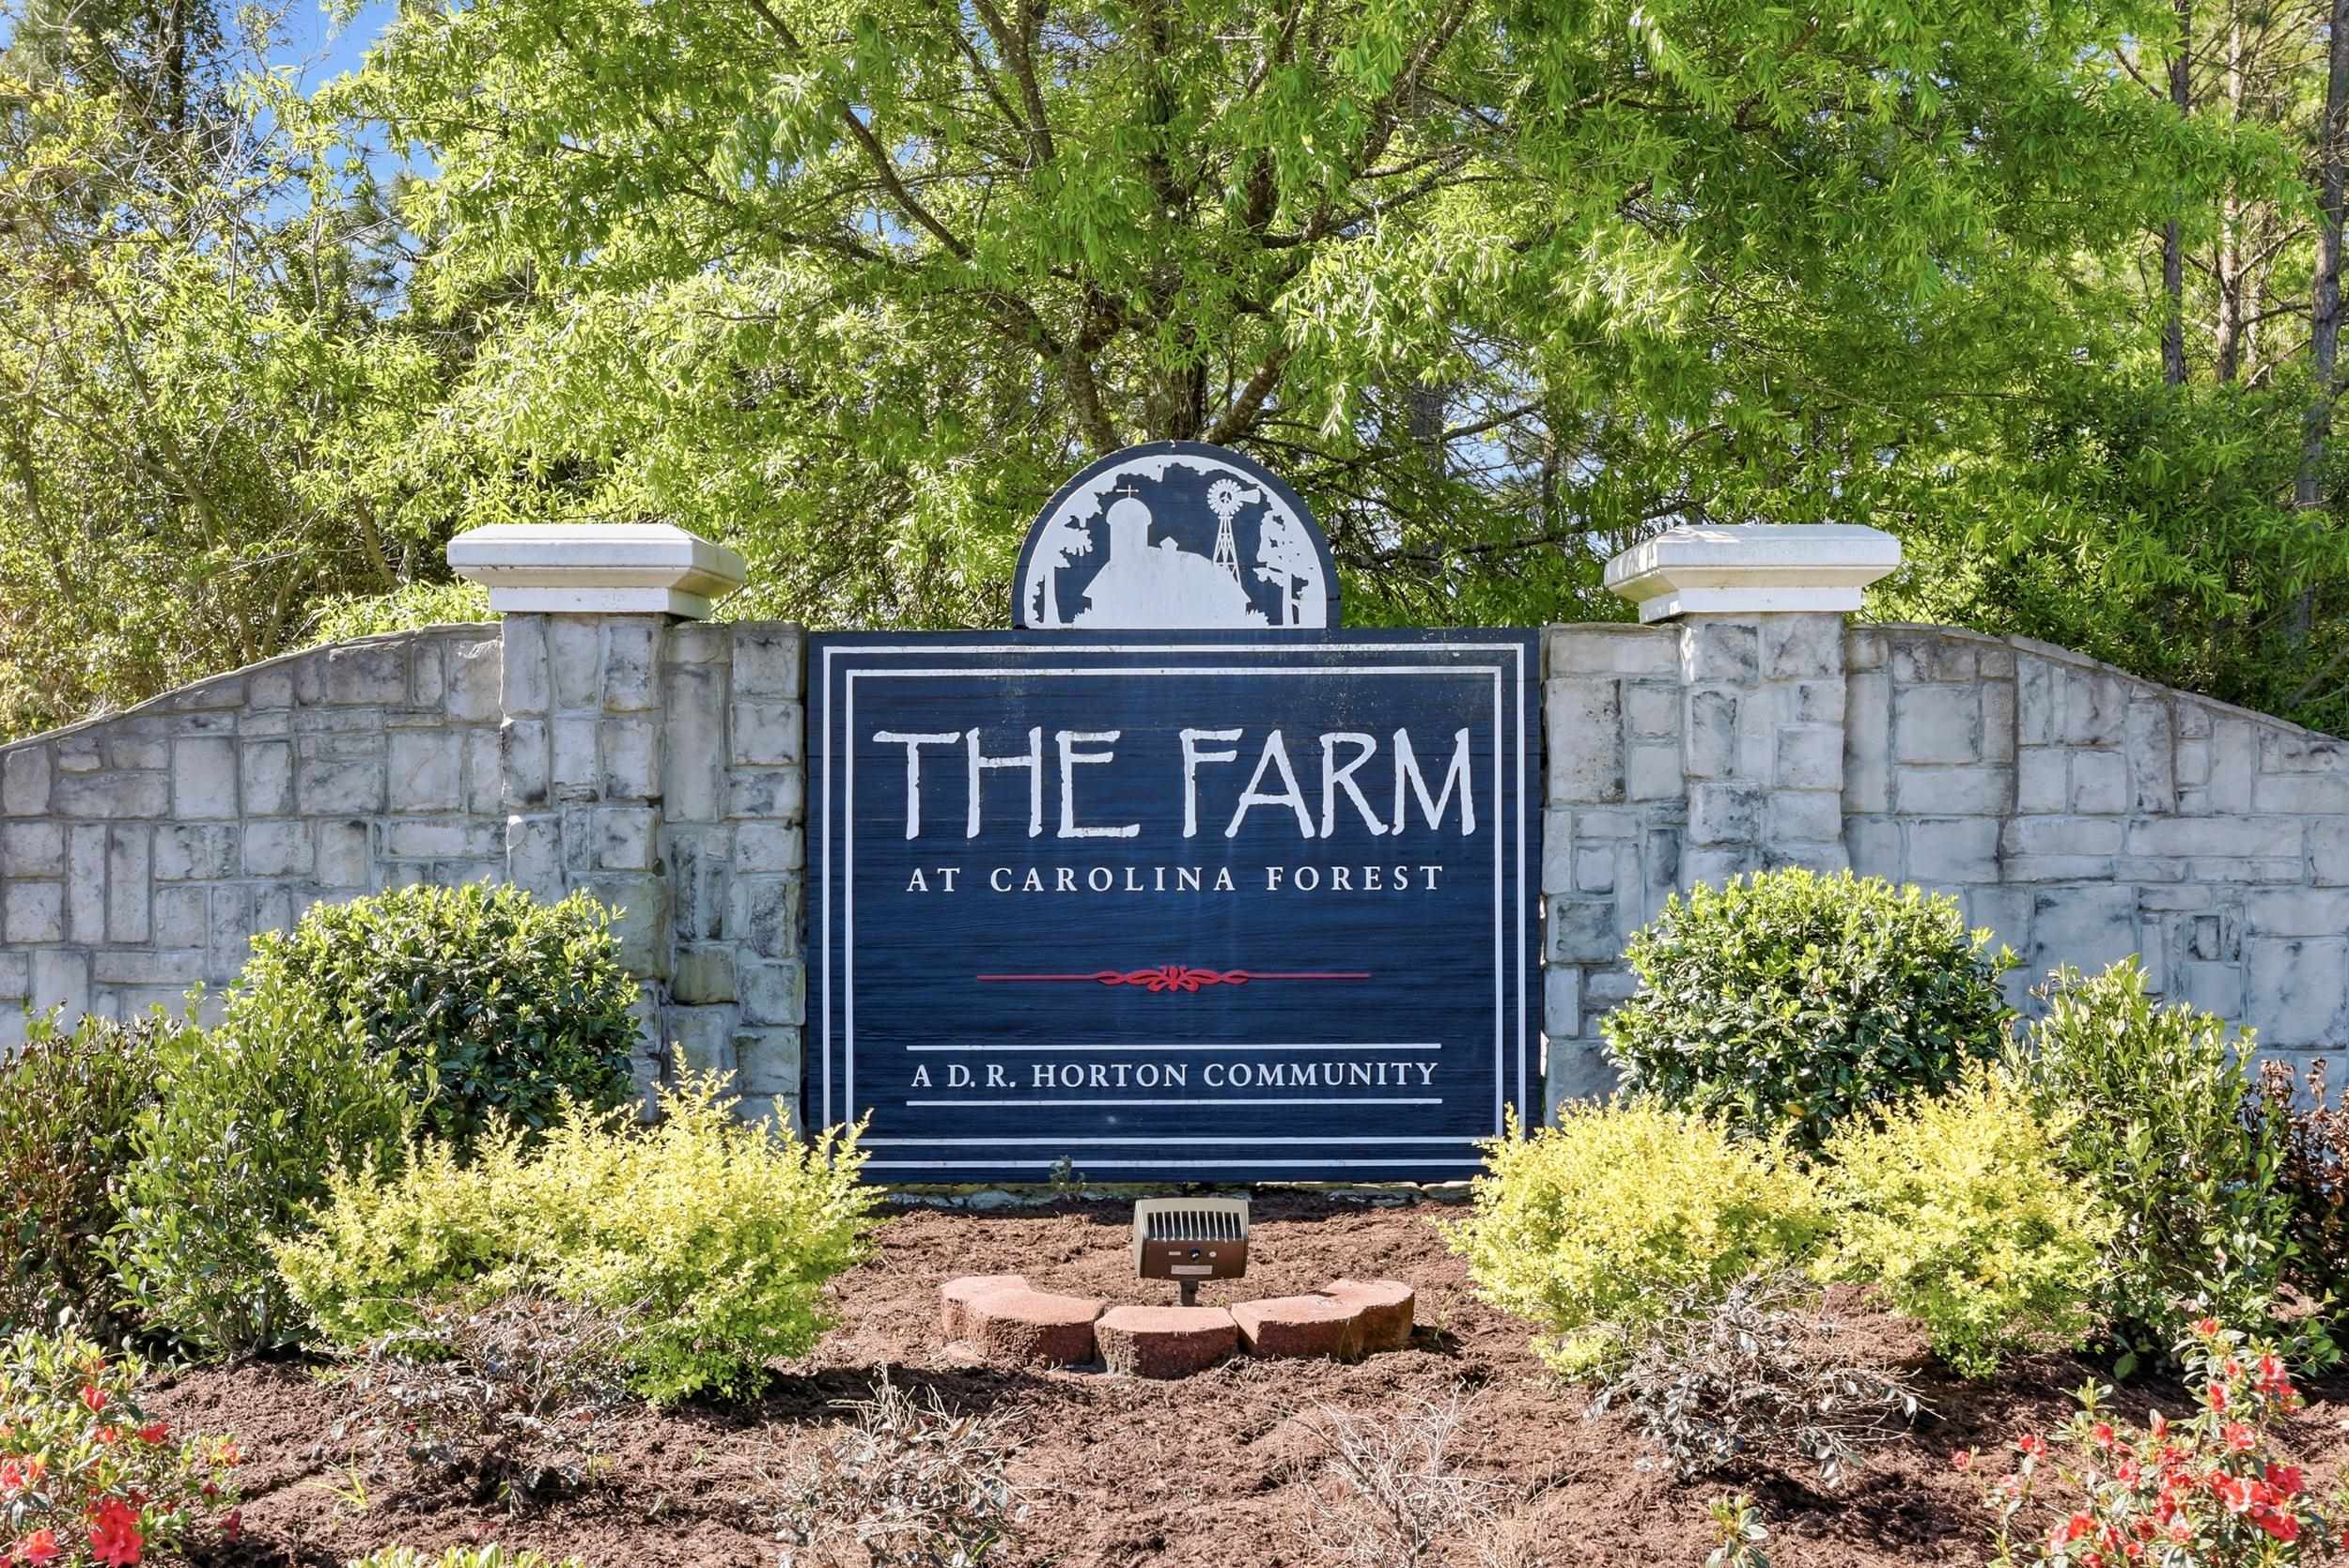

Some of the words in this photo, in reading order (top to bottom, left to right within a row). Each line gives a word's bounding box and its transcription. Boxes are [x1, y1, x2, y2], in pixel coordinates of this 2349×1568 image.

[874, 726, 1140, 839] THE
[1179, 728, 1475, 838] FARM
[907, 868, 959, 892] AT
[991, 867, 1235, 892] CAROLINA
[1267, 866, 1443, 892] FOREST
[911, 1065, 933, 1087] A
[1033, 1064, 1189, 1087] HORTON
[1204, 1063, 1438, 1087] COMMUNITY
